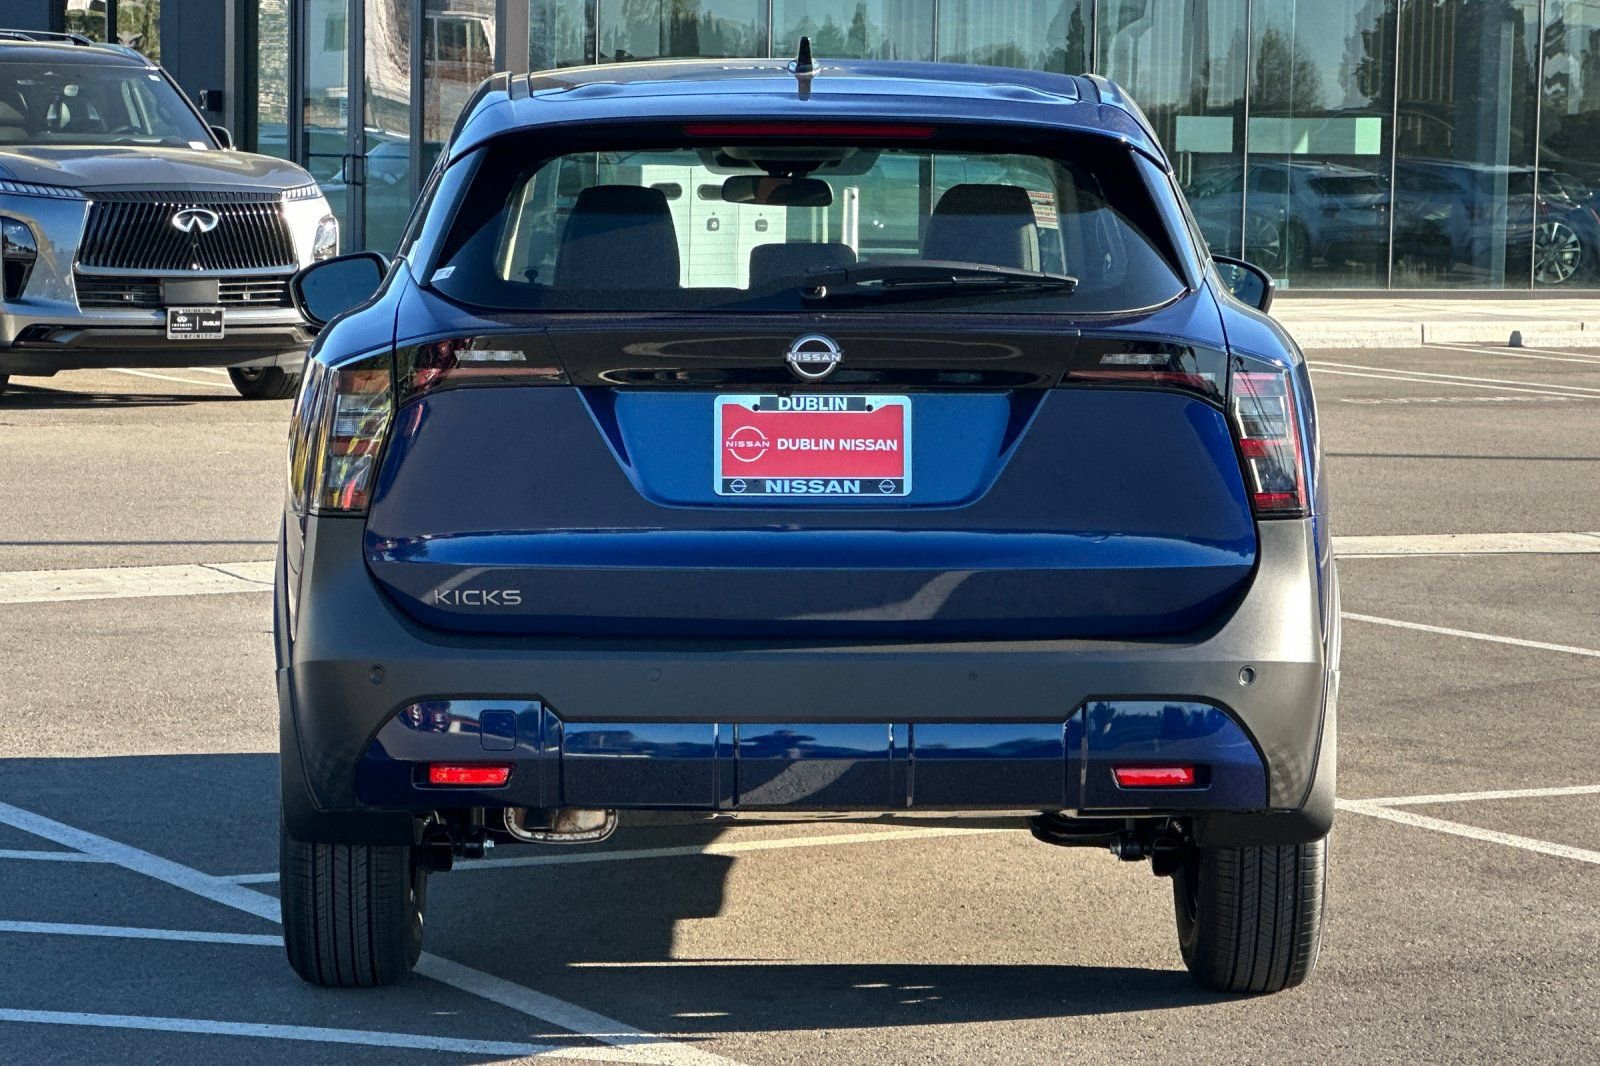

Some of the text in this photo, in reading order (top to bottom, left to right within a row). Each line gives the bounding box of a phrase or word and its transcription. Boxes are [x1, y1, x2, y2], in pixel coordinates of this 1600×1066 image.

[778, 397, 847, 411] DUBLIN
[777, 438, 898, 451] DUBLIN NISSAN
[765, 480, 861, 493] NISSAN
[434, 590, 522, 605] KICKS
